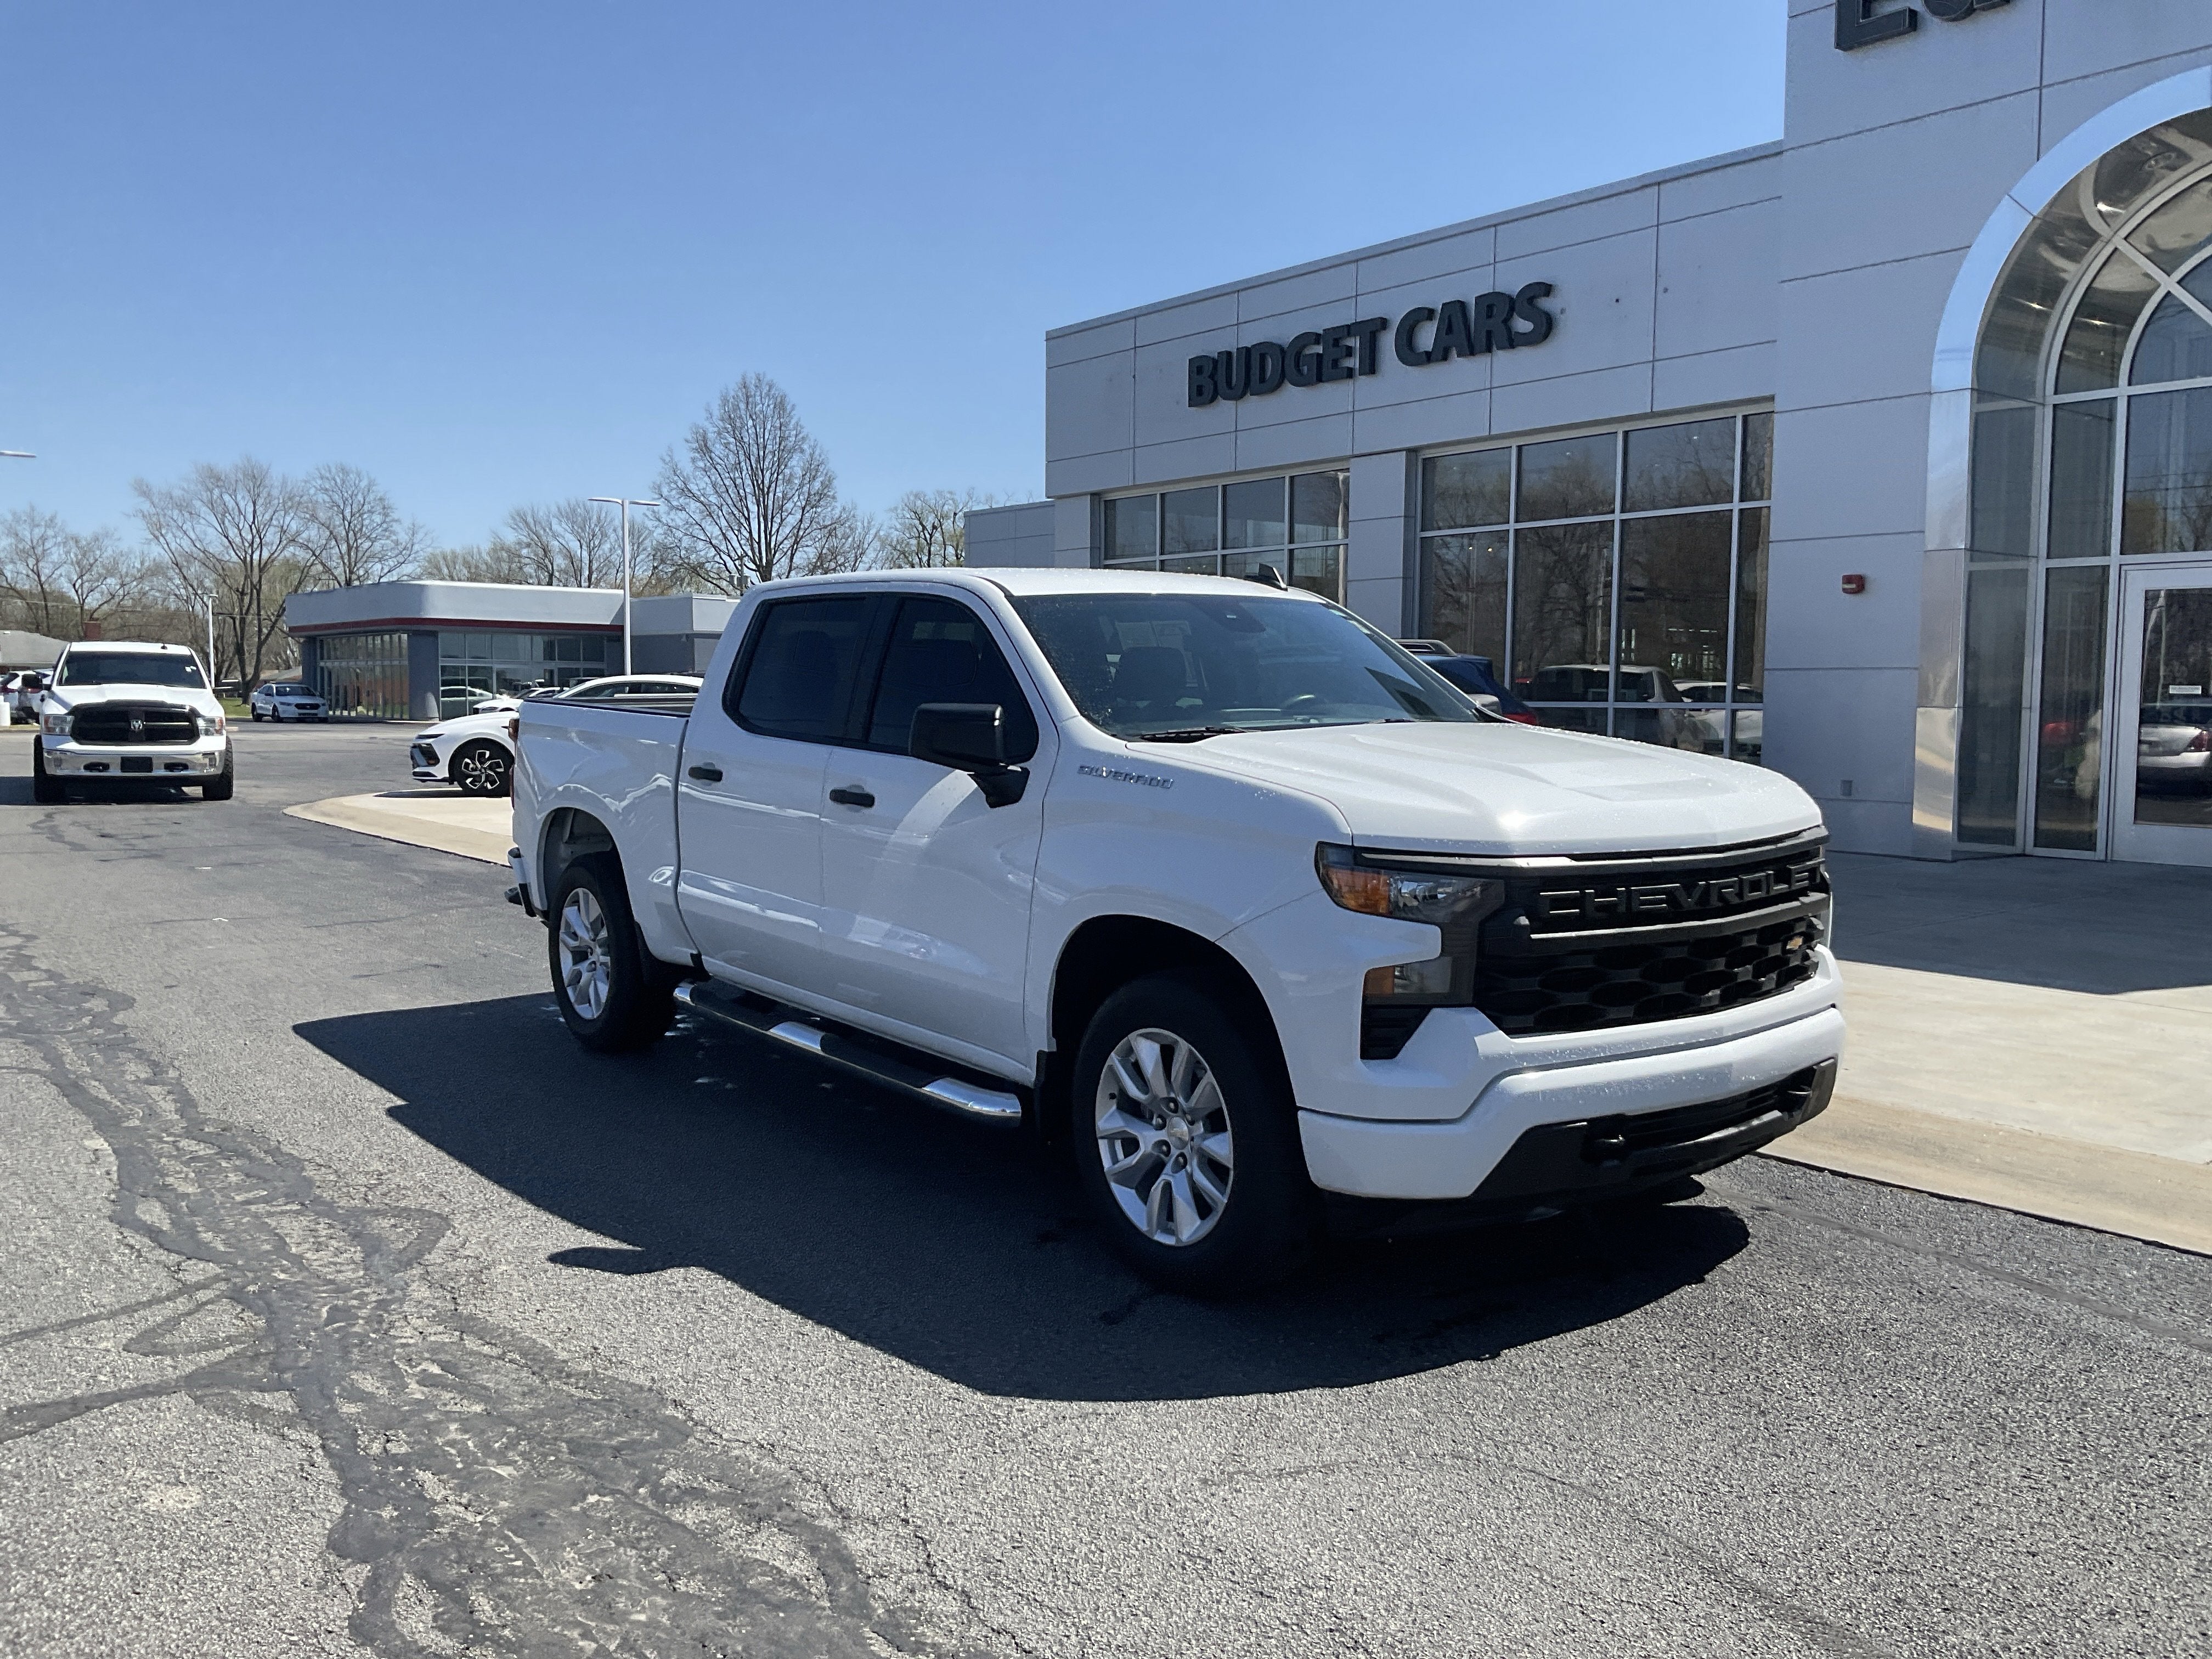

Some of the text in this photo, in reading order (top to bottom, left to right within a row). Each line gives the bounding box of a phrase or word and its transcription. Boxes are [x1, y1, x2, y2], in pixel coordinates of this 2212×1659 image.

[1188, 281, 1553, 407] BUDGET CARS
[1077, 765, 1174, 789] SILVERADO
